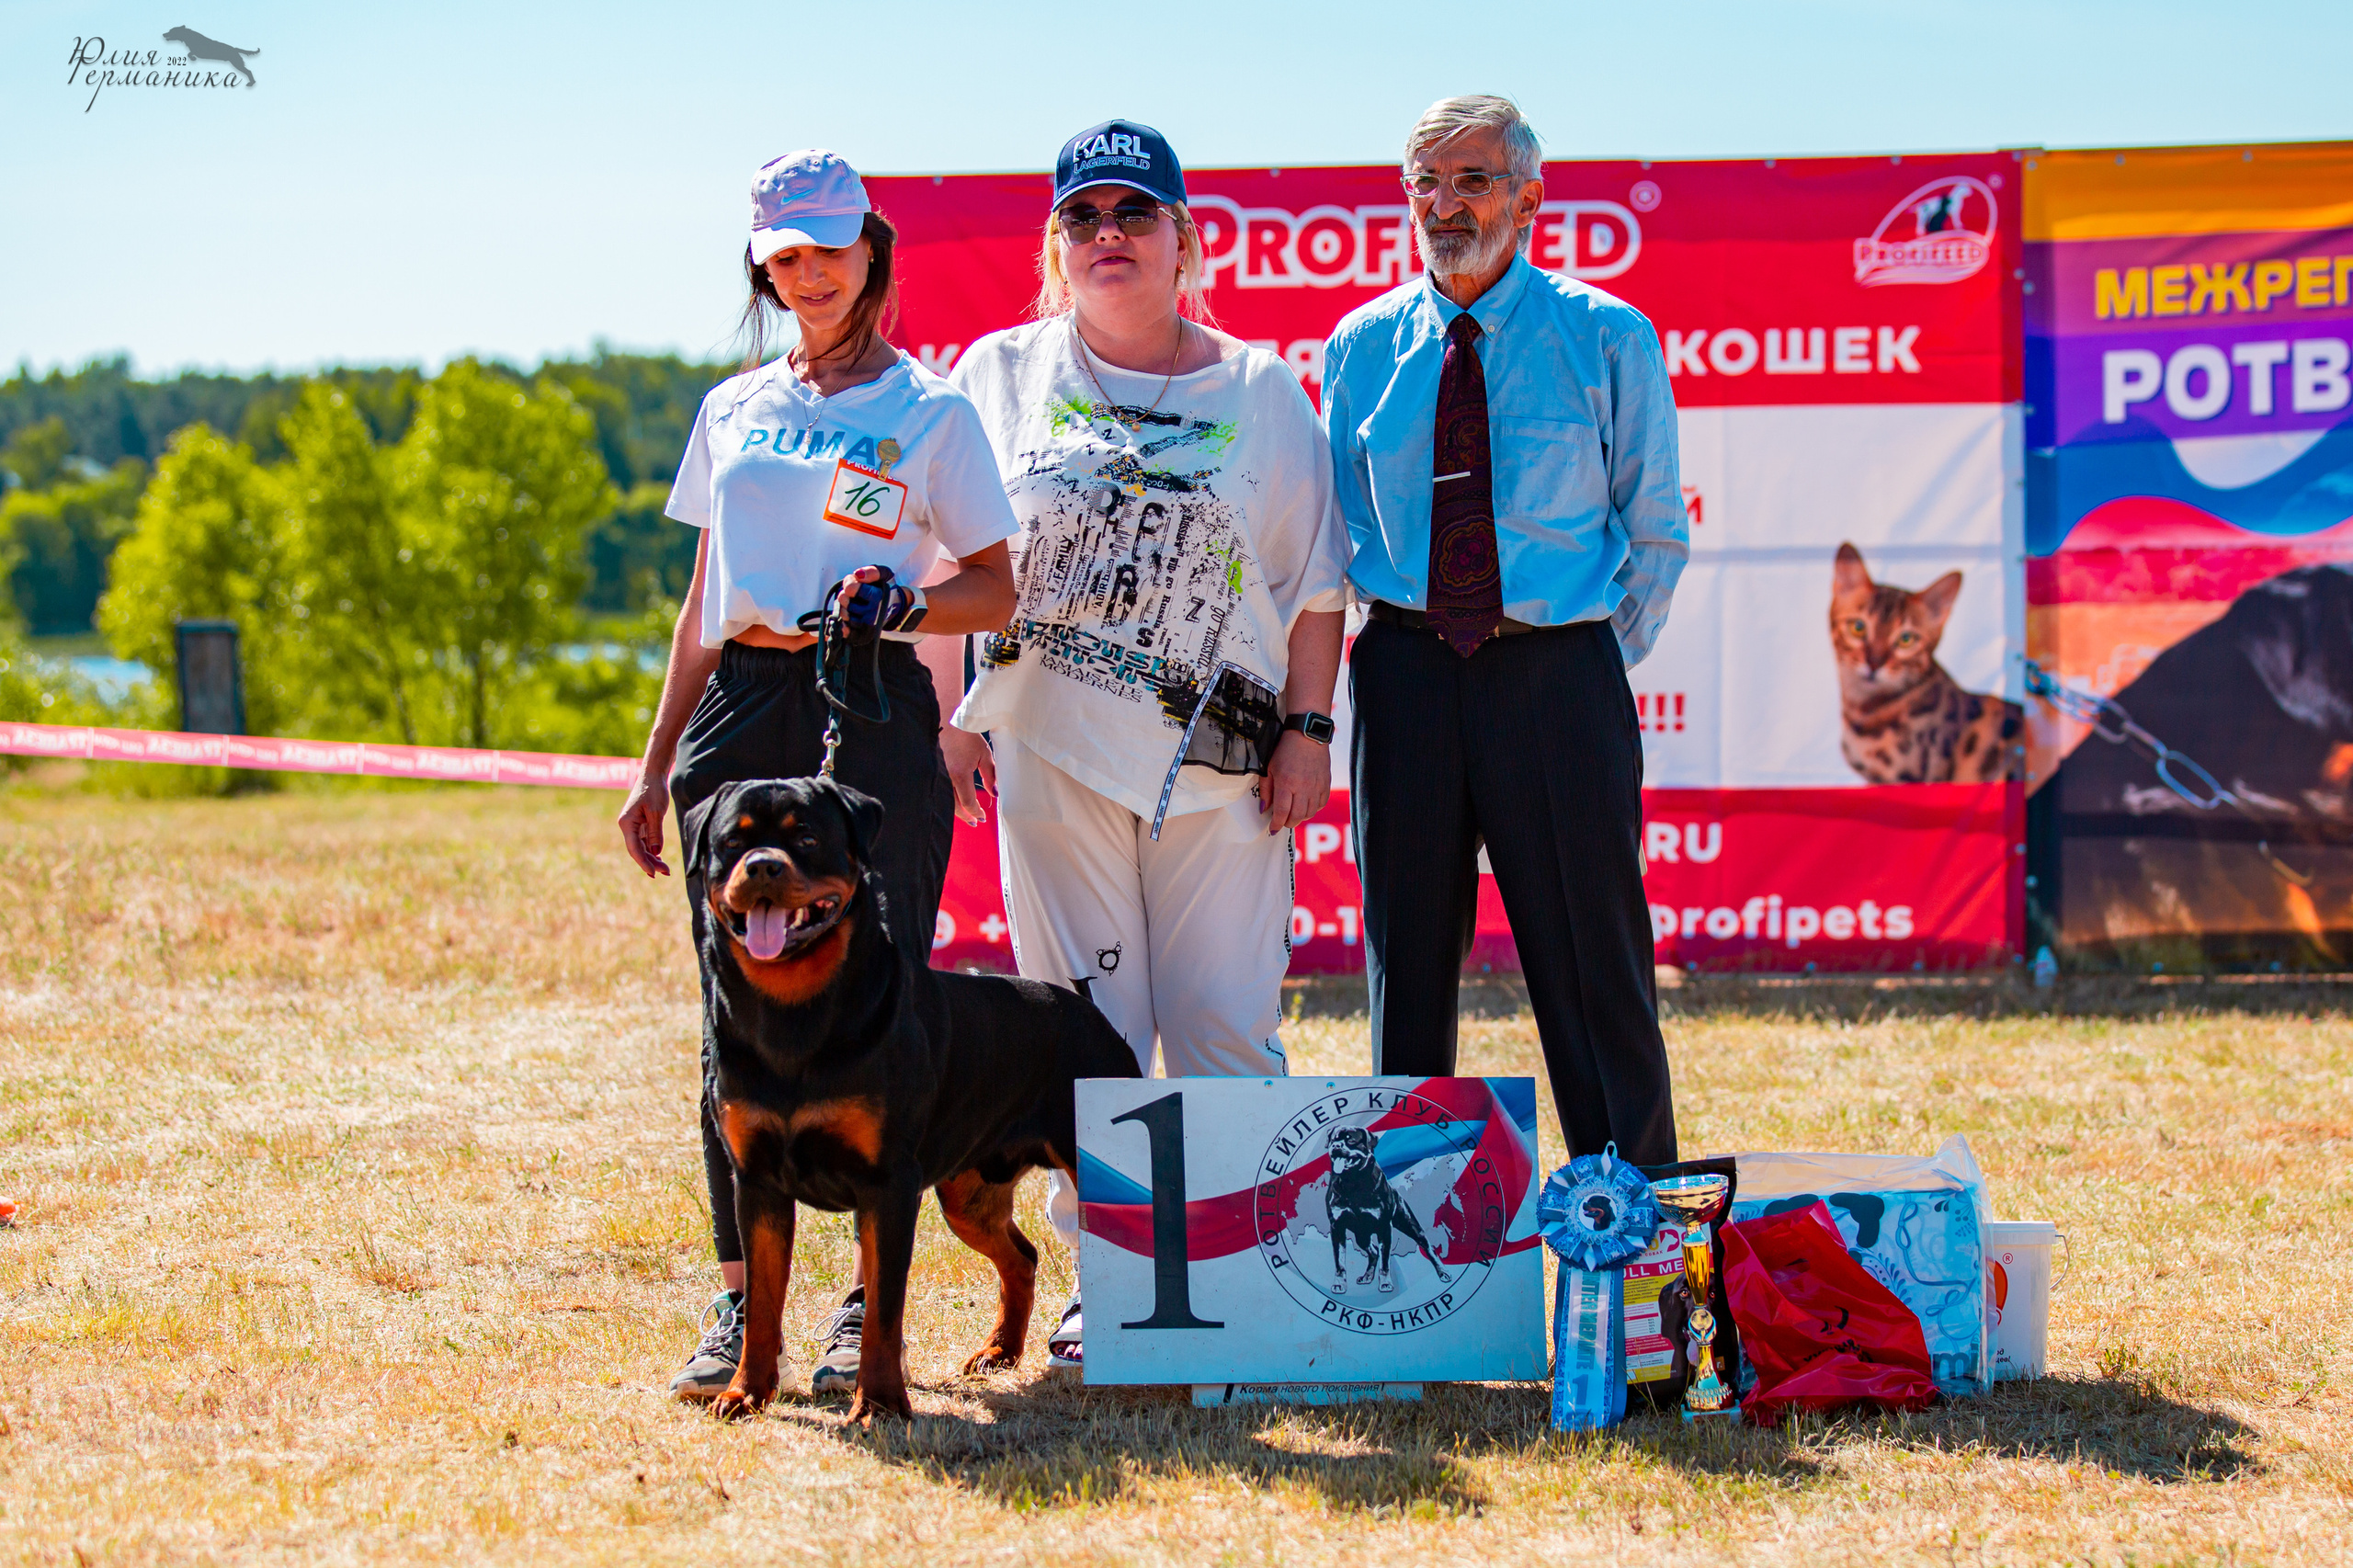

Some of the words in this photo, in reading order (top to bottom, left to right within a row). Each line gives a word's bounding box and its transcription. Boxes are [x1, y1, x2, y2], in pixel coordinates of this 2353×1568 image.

[1073, 133, 1151, 163] KARL
[1074, 155, 1151, 174] LAGERFELD
[1665, 324, 1923, 377] КОШЕК
[740, 428, 876, 466] PUMA
[845, 481, 891, 517] 16
[1153, 594, 1172, 631] Russia
[1040, 659, 1142, 703] MODERNES
[1041, 653, 1104, 684] JAMAIS
[1258, 1096, 1349, 1270] РОТВЕЙЛЕР
[1368, 1092, 1452, 1131] КЛУБ
[1460, 1138, 1504, 1268] РОССИИ
[1110, 1091, 1225, 1330] 1
[1320, 1292, 1454, 1330] РКФ-НКПР
[1239, 1384, 1278, 1394] Корма
[1280, 1384, 1319, 1393] нового
[1572, 1373, 1589, 1405] 1
